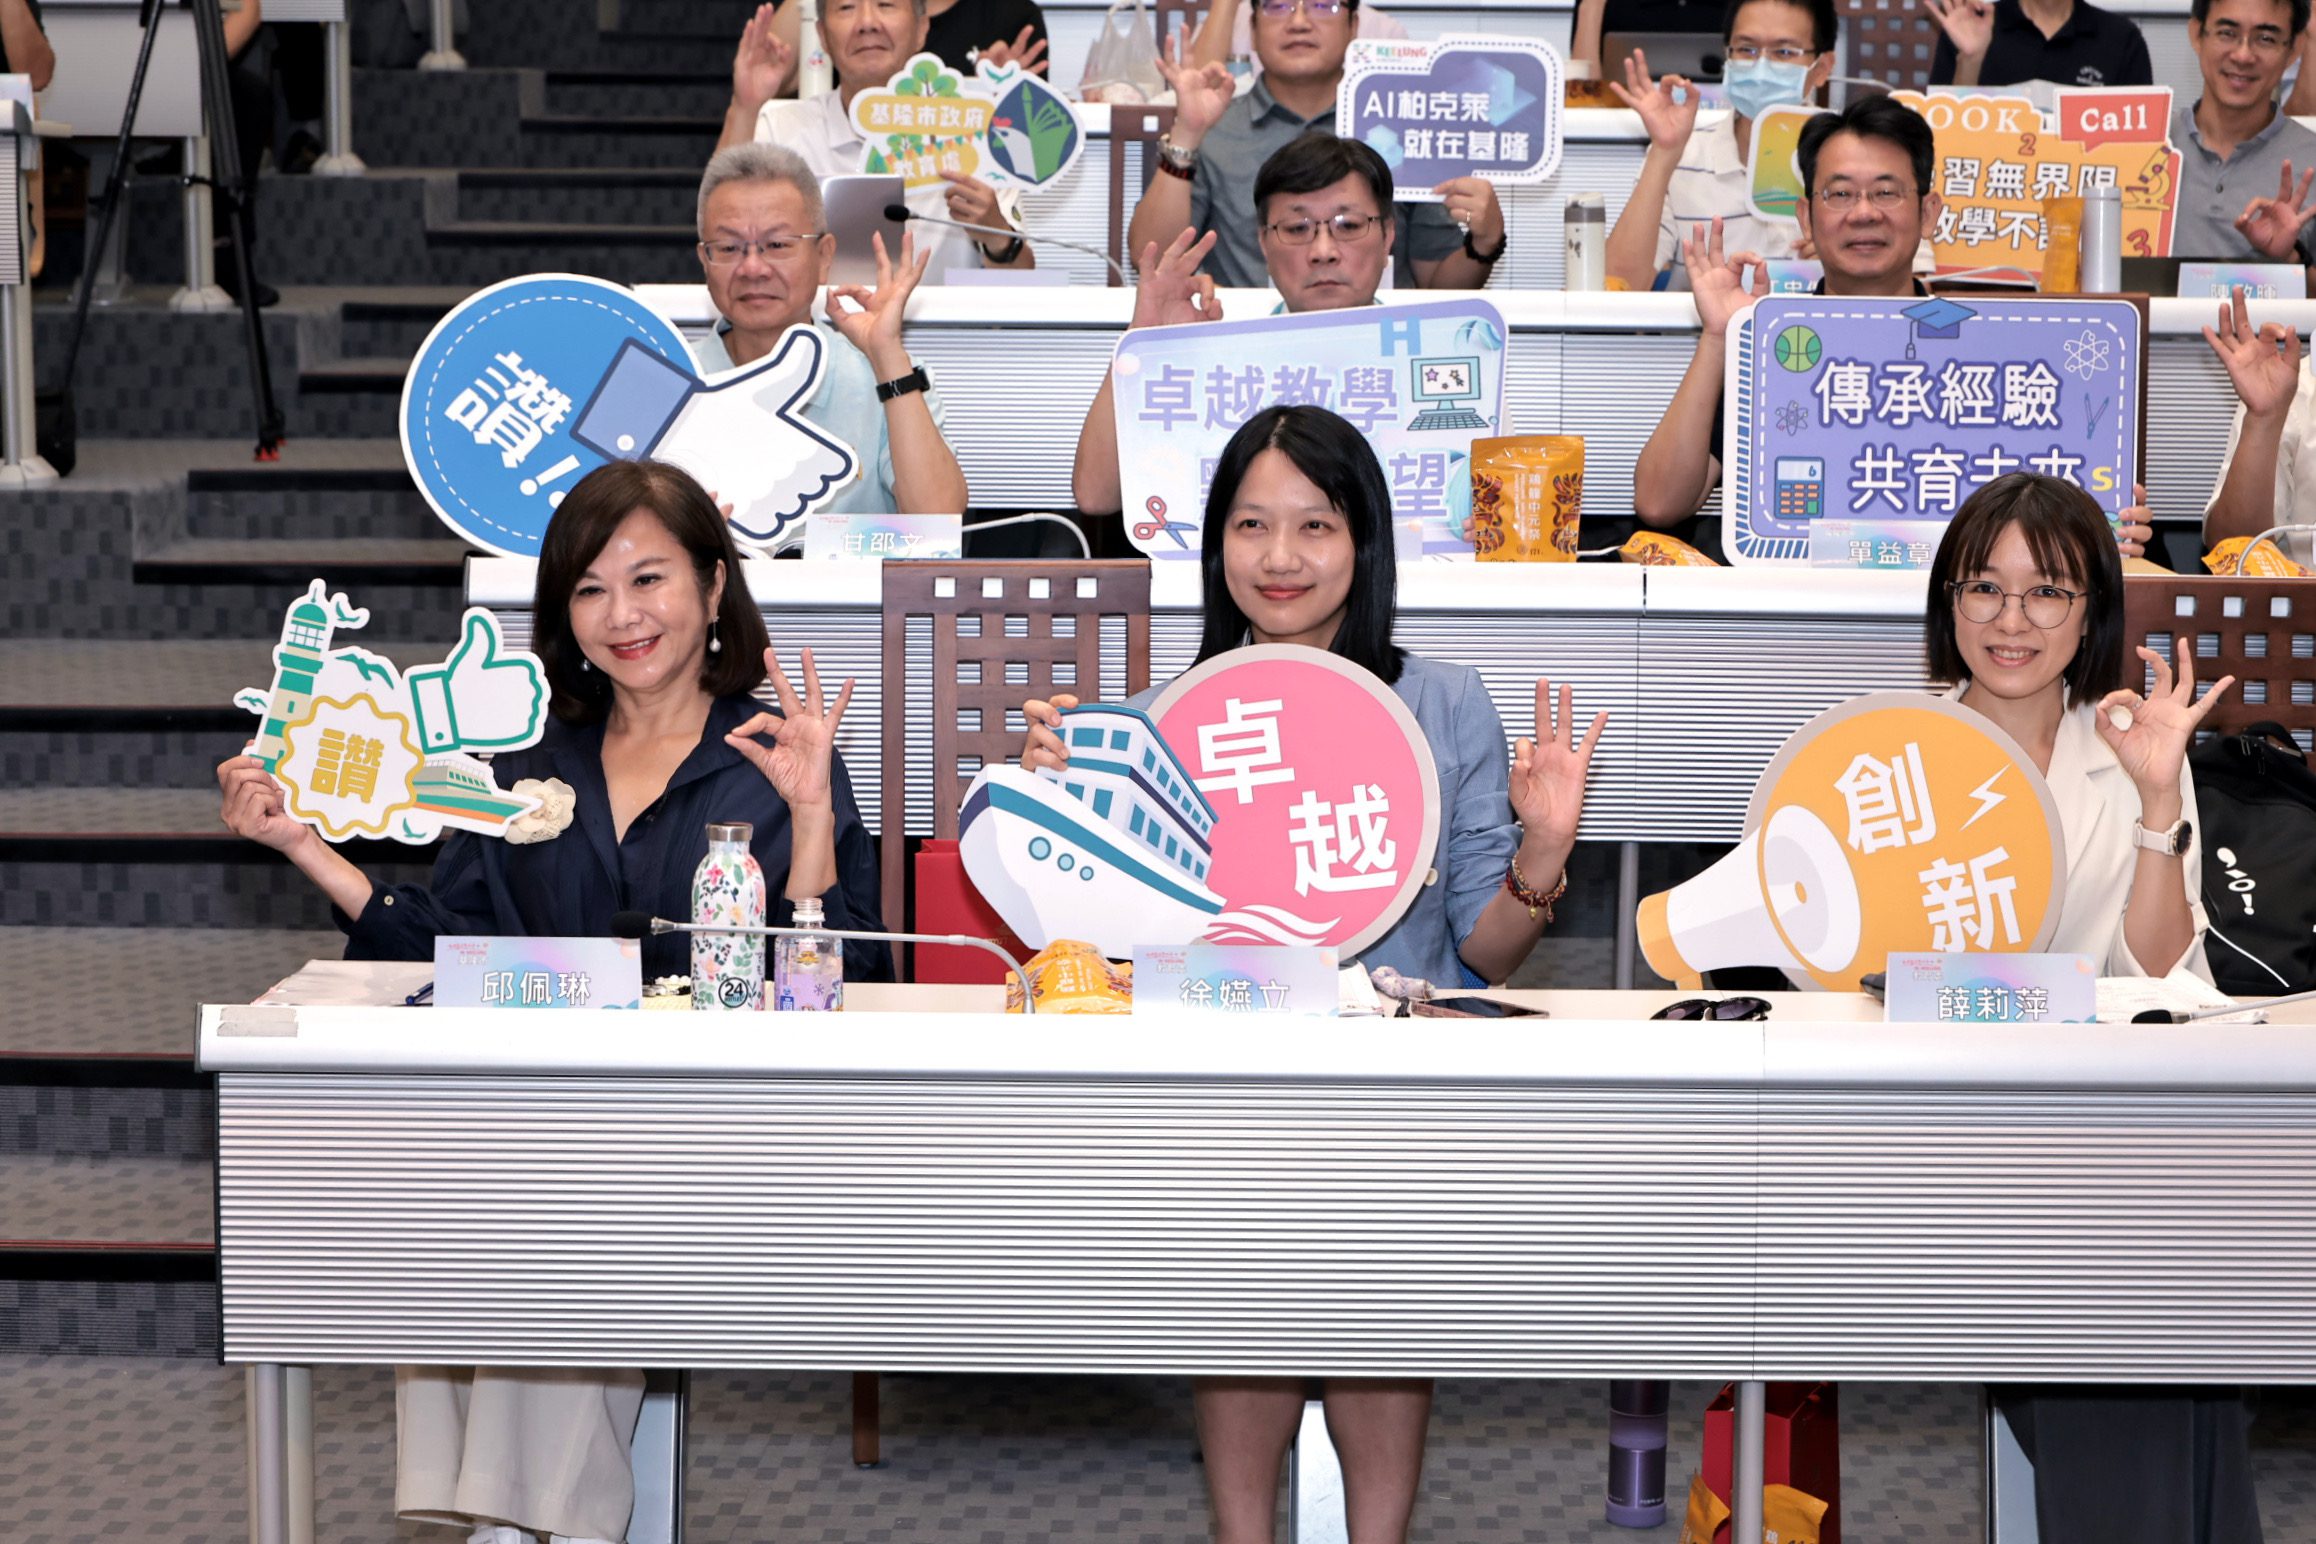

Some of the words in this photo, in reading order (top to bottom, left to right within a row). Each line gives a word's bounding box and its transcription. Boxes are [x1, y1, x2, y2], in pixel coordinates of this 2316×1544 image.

[870, 102, 985, 128] 基隆市政府
[1362, 89, 1491, 122] AI柏克萊
[1905, 104, 2024, 134] OOK
[2079, 104, 2148, 133] Call
[1403, 128, 1529, 162] 就在基隆
[2018, 133, 2037, 156] 2
[1930, 156, 2118, 201] 習無界限
[1379, 316, 1422, 356] H
[1138, 363, 1399, 433] 卓越教學
[1815, 361, 2059, 427] 傳承經驗
[1848, 540, 1931, 565] 單益章
[309, 728, 385, 803] 讚
[481, 971, 592, 1006] 邱佩琳
[724, 981, 745, 997] 24
[1936, 986, 2049, 1021] 薛莉萍
